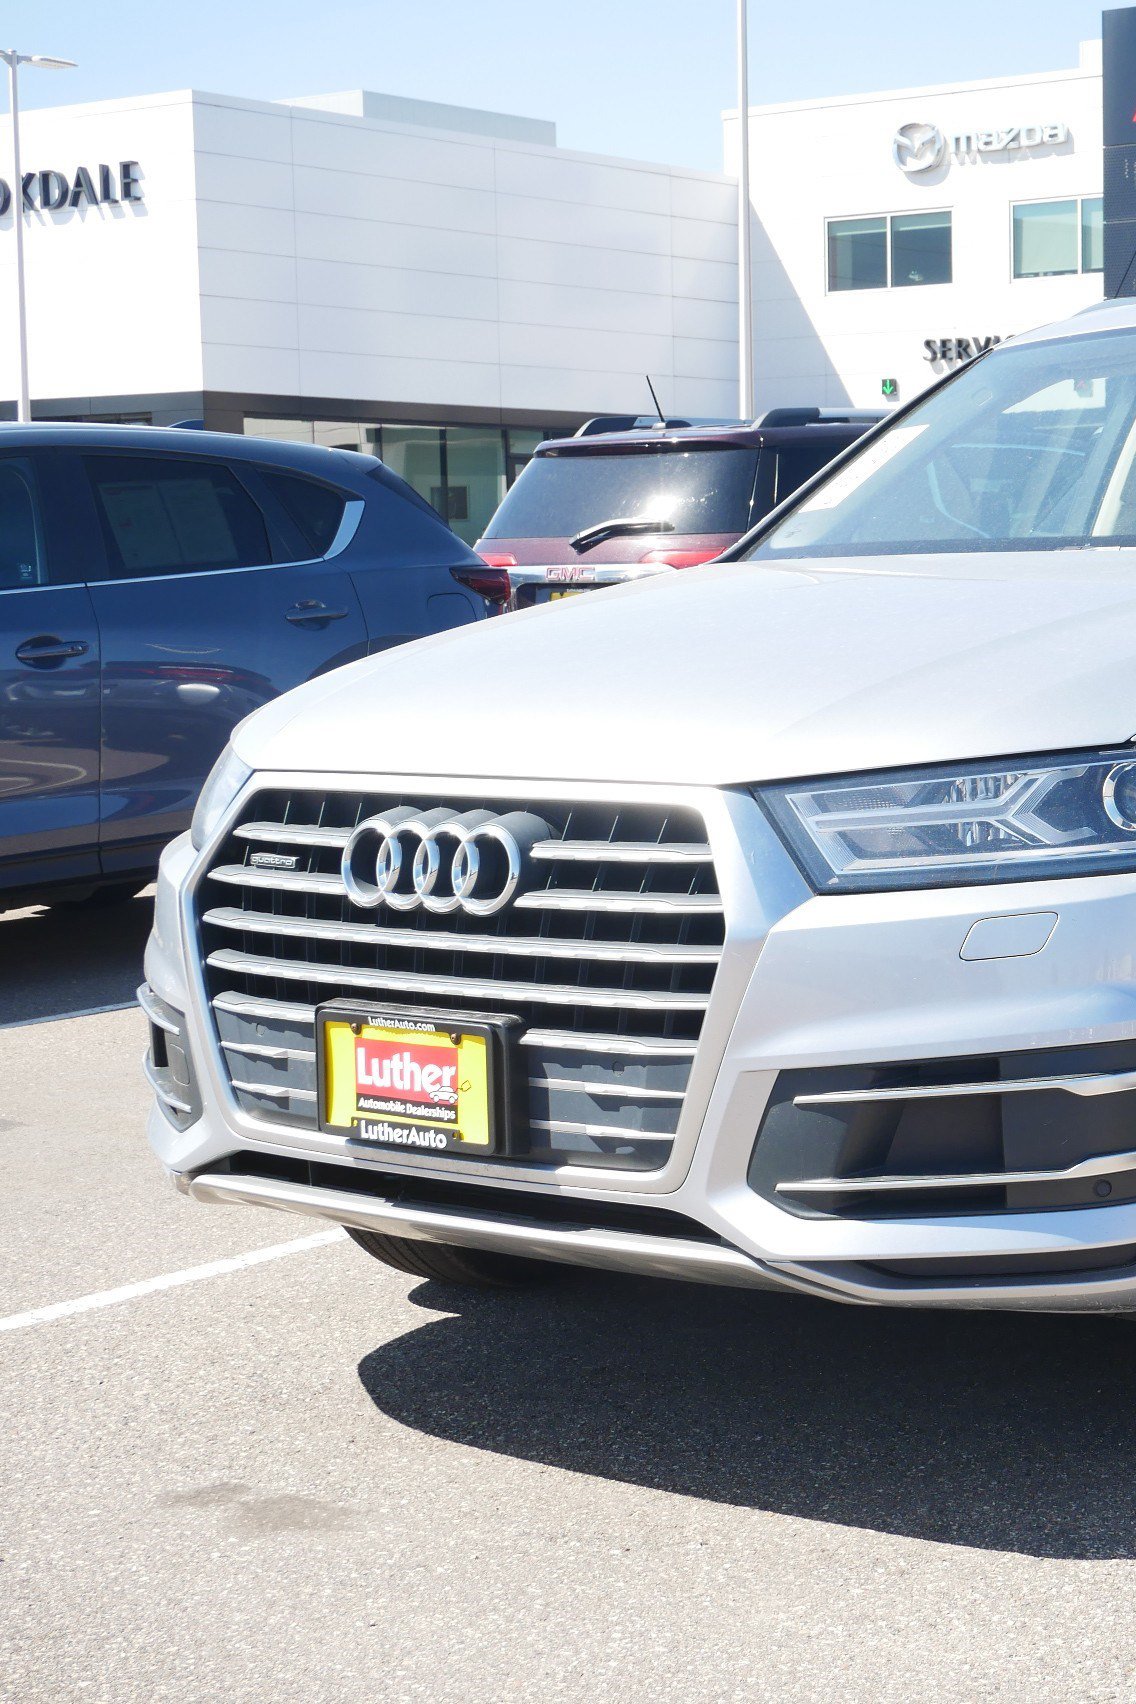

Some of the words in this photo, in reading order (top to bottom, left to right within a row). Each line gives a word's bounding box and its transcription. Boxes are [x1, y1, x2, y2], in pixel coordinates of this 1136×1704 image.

[922, 335, 1015, 362] SERV
[545, 567, 596, 581] GMC
[251, 855, 295, 867] quattro
[367, 1016, 436, 1032] LutherAuto.com
[357, 1046, 457, 1093] Luther
[358, 1096, 406, 1113] Automobile
[406, 1103, 456, 1120] Dealerships
[360, 1120, 448, 1149] LutherAuto
